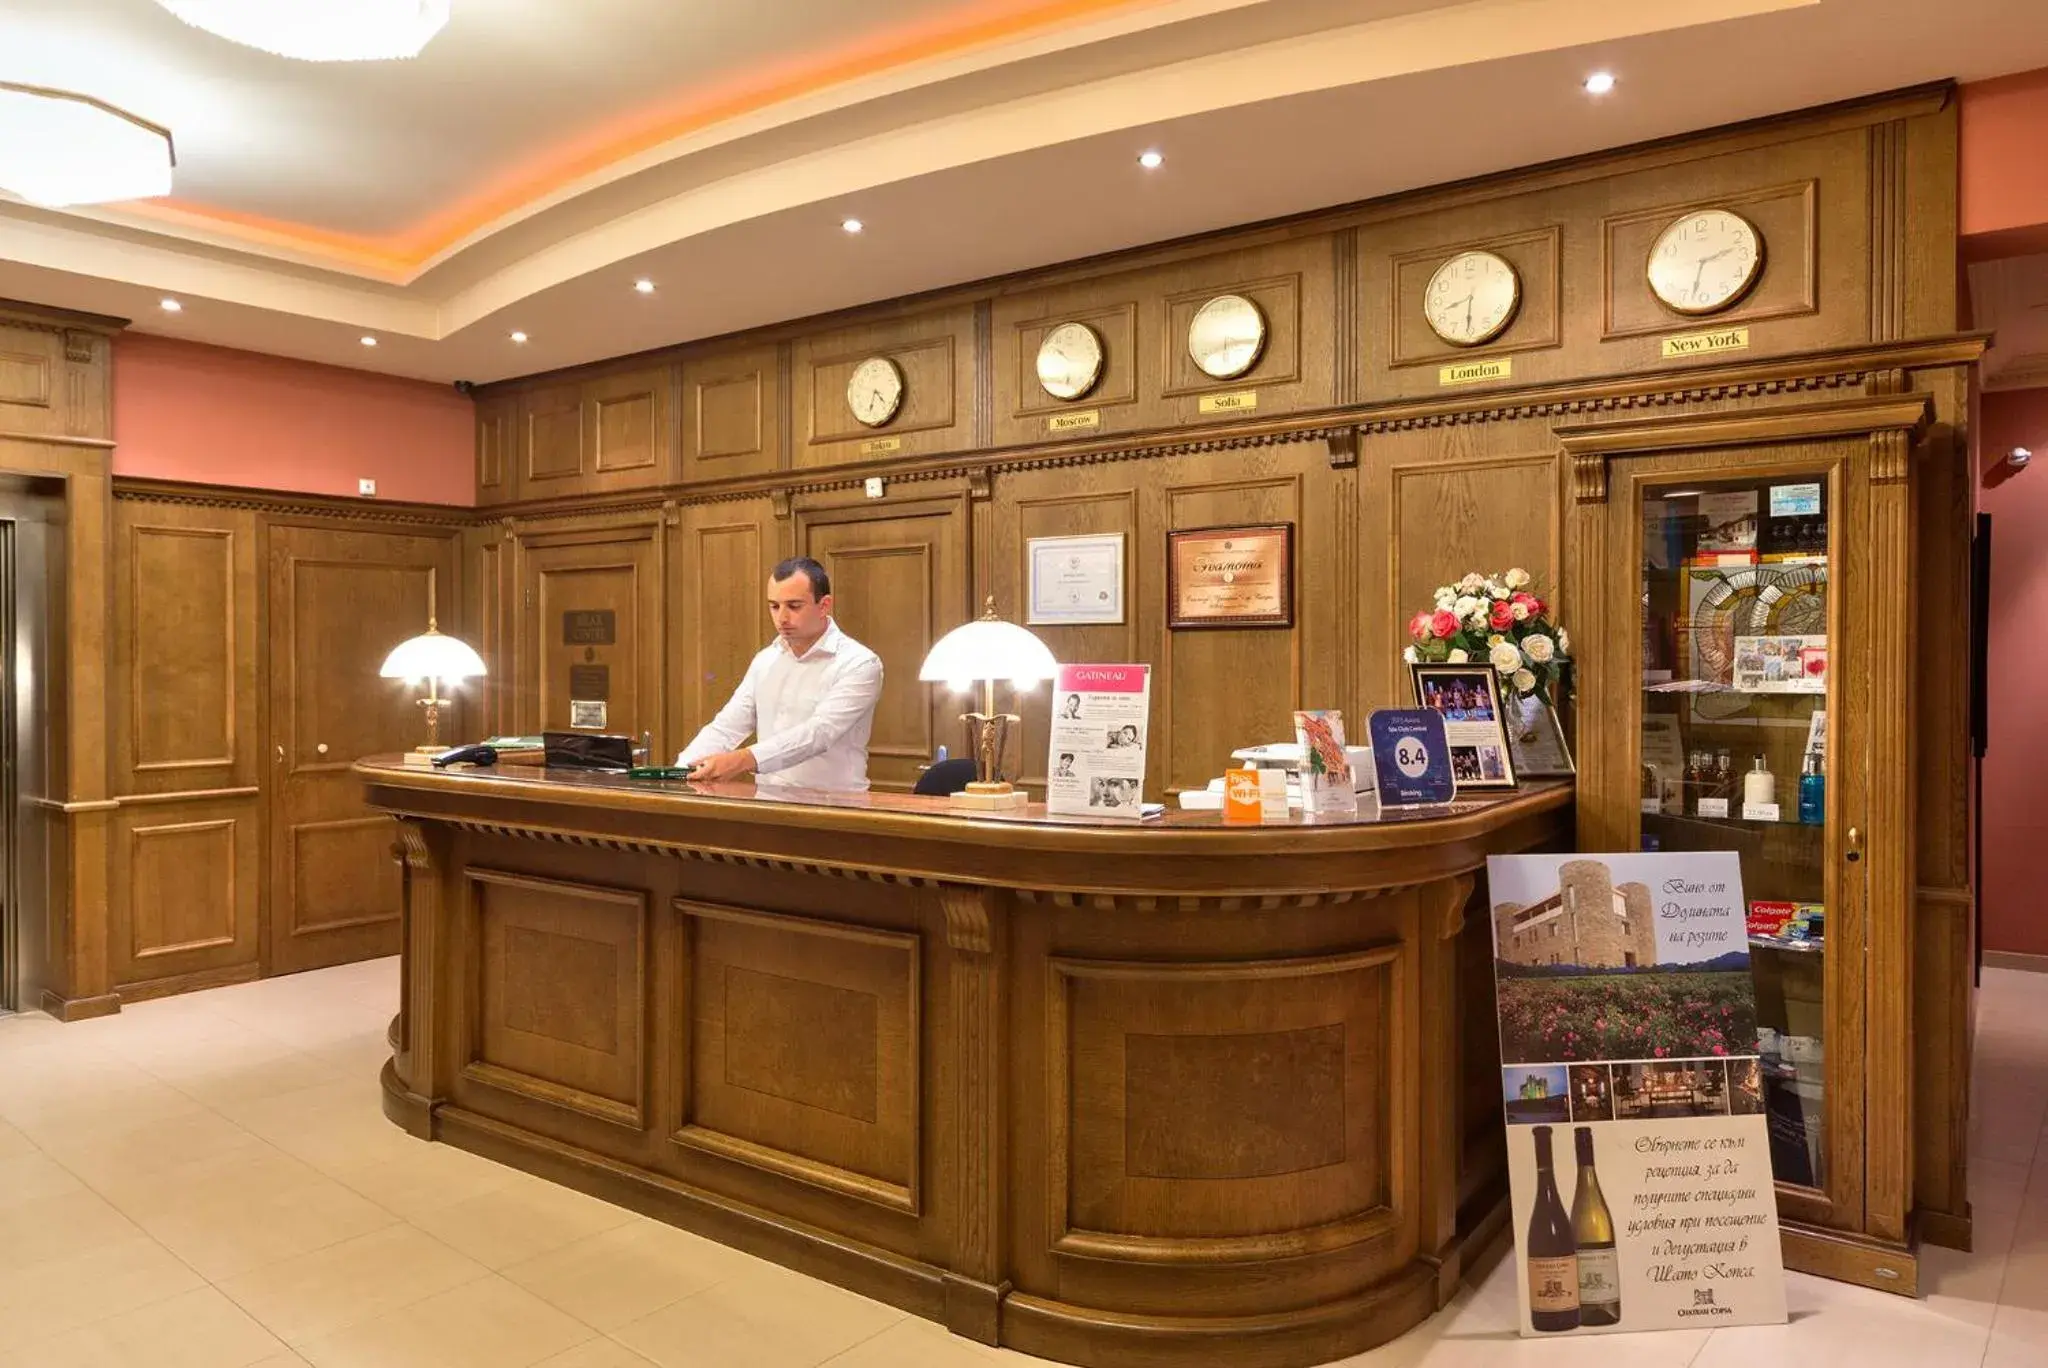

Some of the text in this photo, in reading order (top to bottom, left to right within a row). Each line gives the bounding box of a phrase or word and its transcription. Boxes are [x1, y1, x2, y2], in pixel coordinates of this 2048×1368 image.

[1670, 331, 1741, 352] New York
[1449, 363, 1501, 380] London
[1214, 396, 1242, 410] Sofia
[1055, 414, 1091, 428] Moscow
[1075, 671, 1127, 681] GATINEAU
[1399, 747, 1426, 766] 8.4
[1662, 878, 1726, 894] Вино от
[1660, 902, 1731, 923] Долината
[1754, 905, 1791, 915] Colgate
[1747, 921, 1780, 930] olgate
[1669, 929, 1729, 948] на розите
[1635, 1136, 1745, 1156] Обърнете се към
[1704, 1164, 1720, 1181] за
[1723, 1158, 1740, 1175] да
[1633, 1189, 1757, 1210] получите специални
[1626, 1213, 1768, 1238] условия при посещение
[1652, 1246, 1660, 1256] и
[1663, 1239, 1735, 1260] дегустация
[1646, 1264, 1698, 1283] Шато
